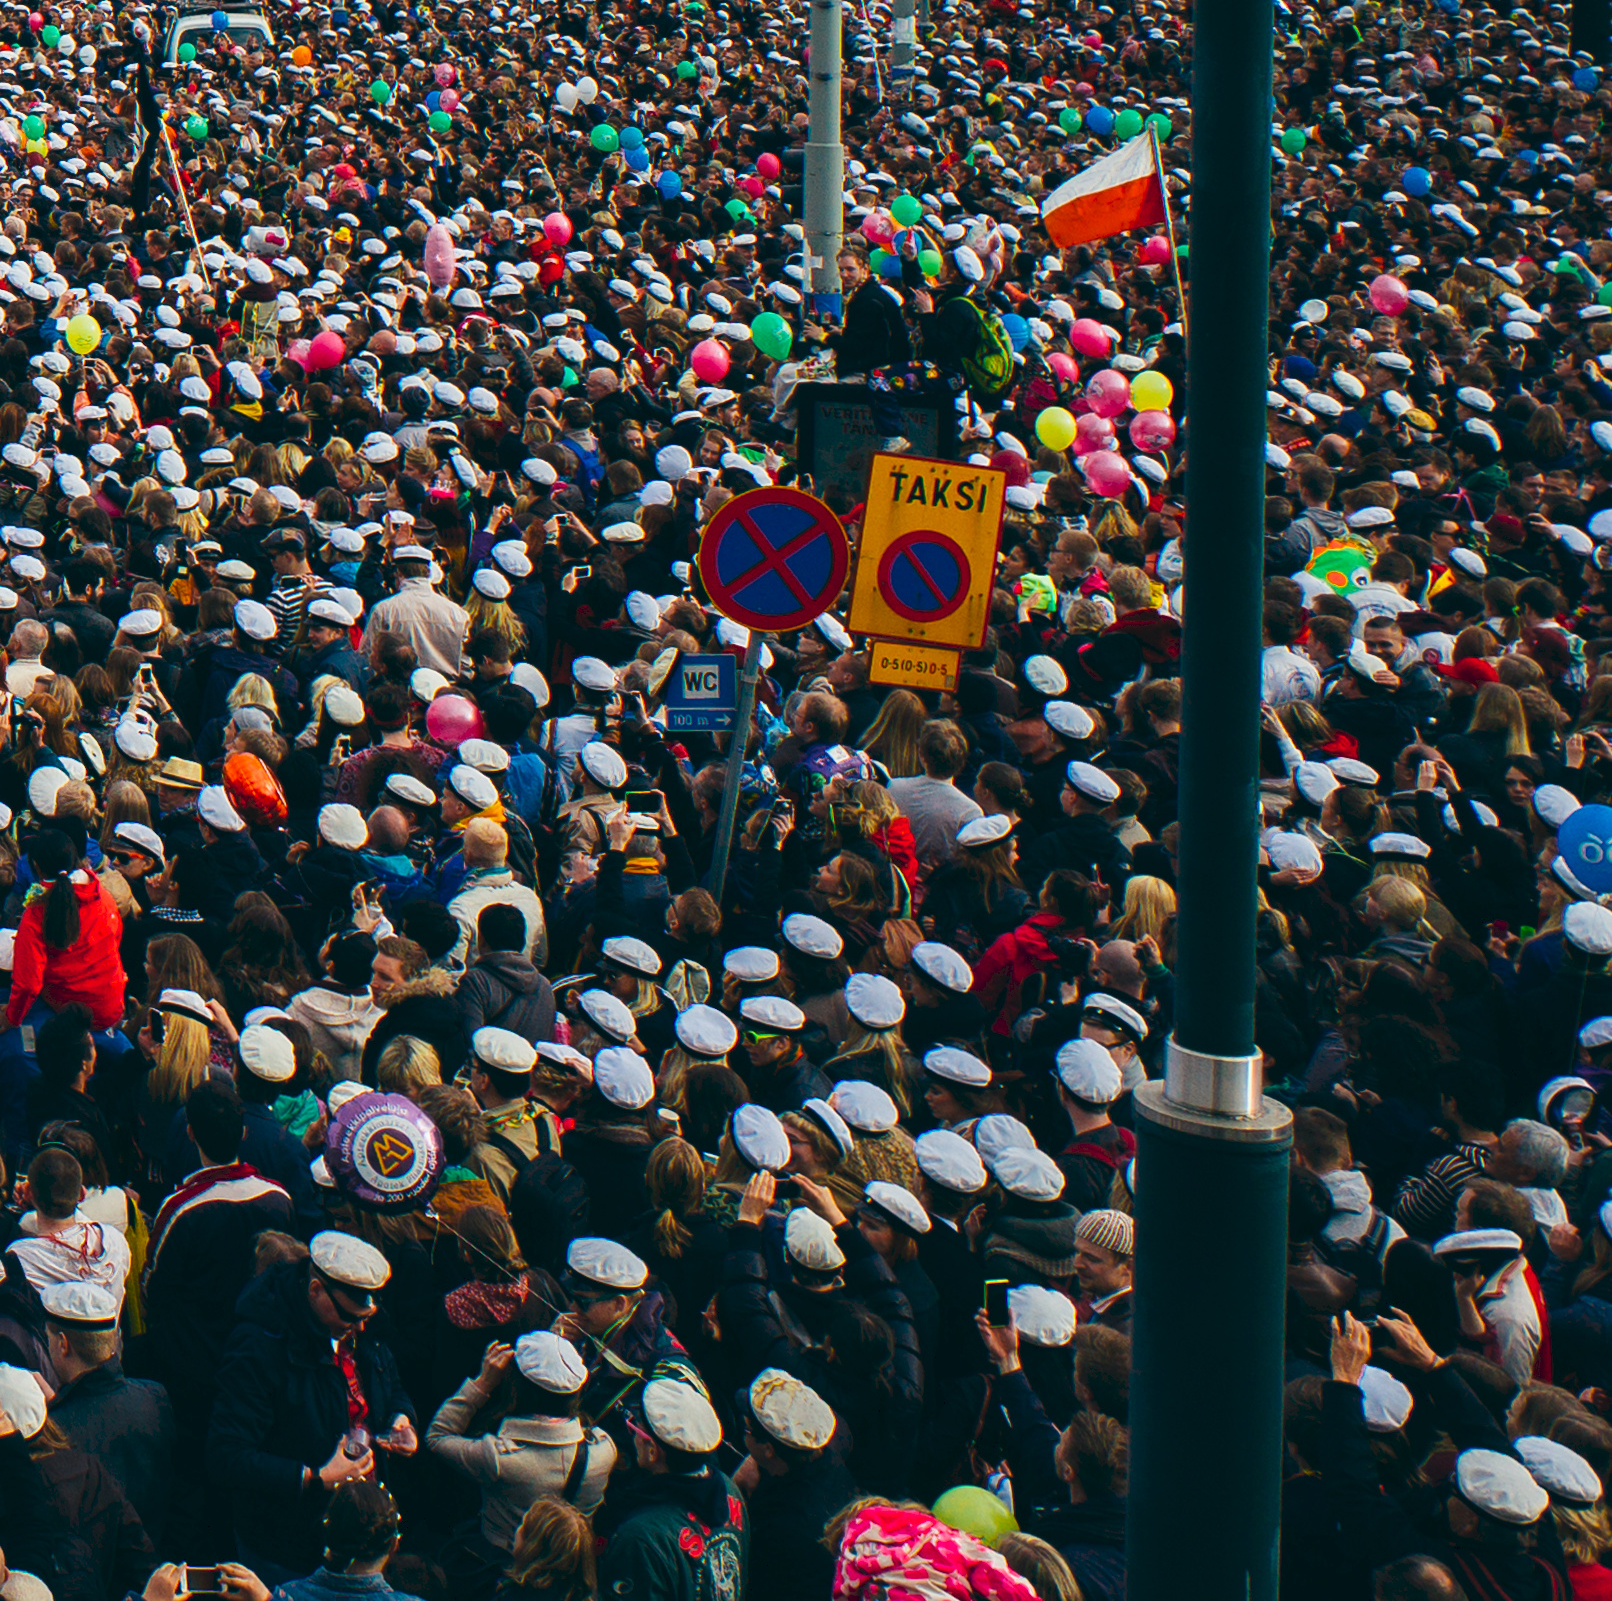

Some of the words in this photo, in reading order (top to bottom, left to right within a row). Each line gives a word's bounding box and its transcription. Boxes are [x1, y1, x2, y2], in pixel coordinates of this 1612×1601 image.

[889, 471, 988, 513] TAKSI
[684, 672, 718, 692] WC
[674, 714, 693, 726] 100
[697, 716, 709, 726] m
